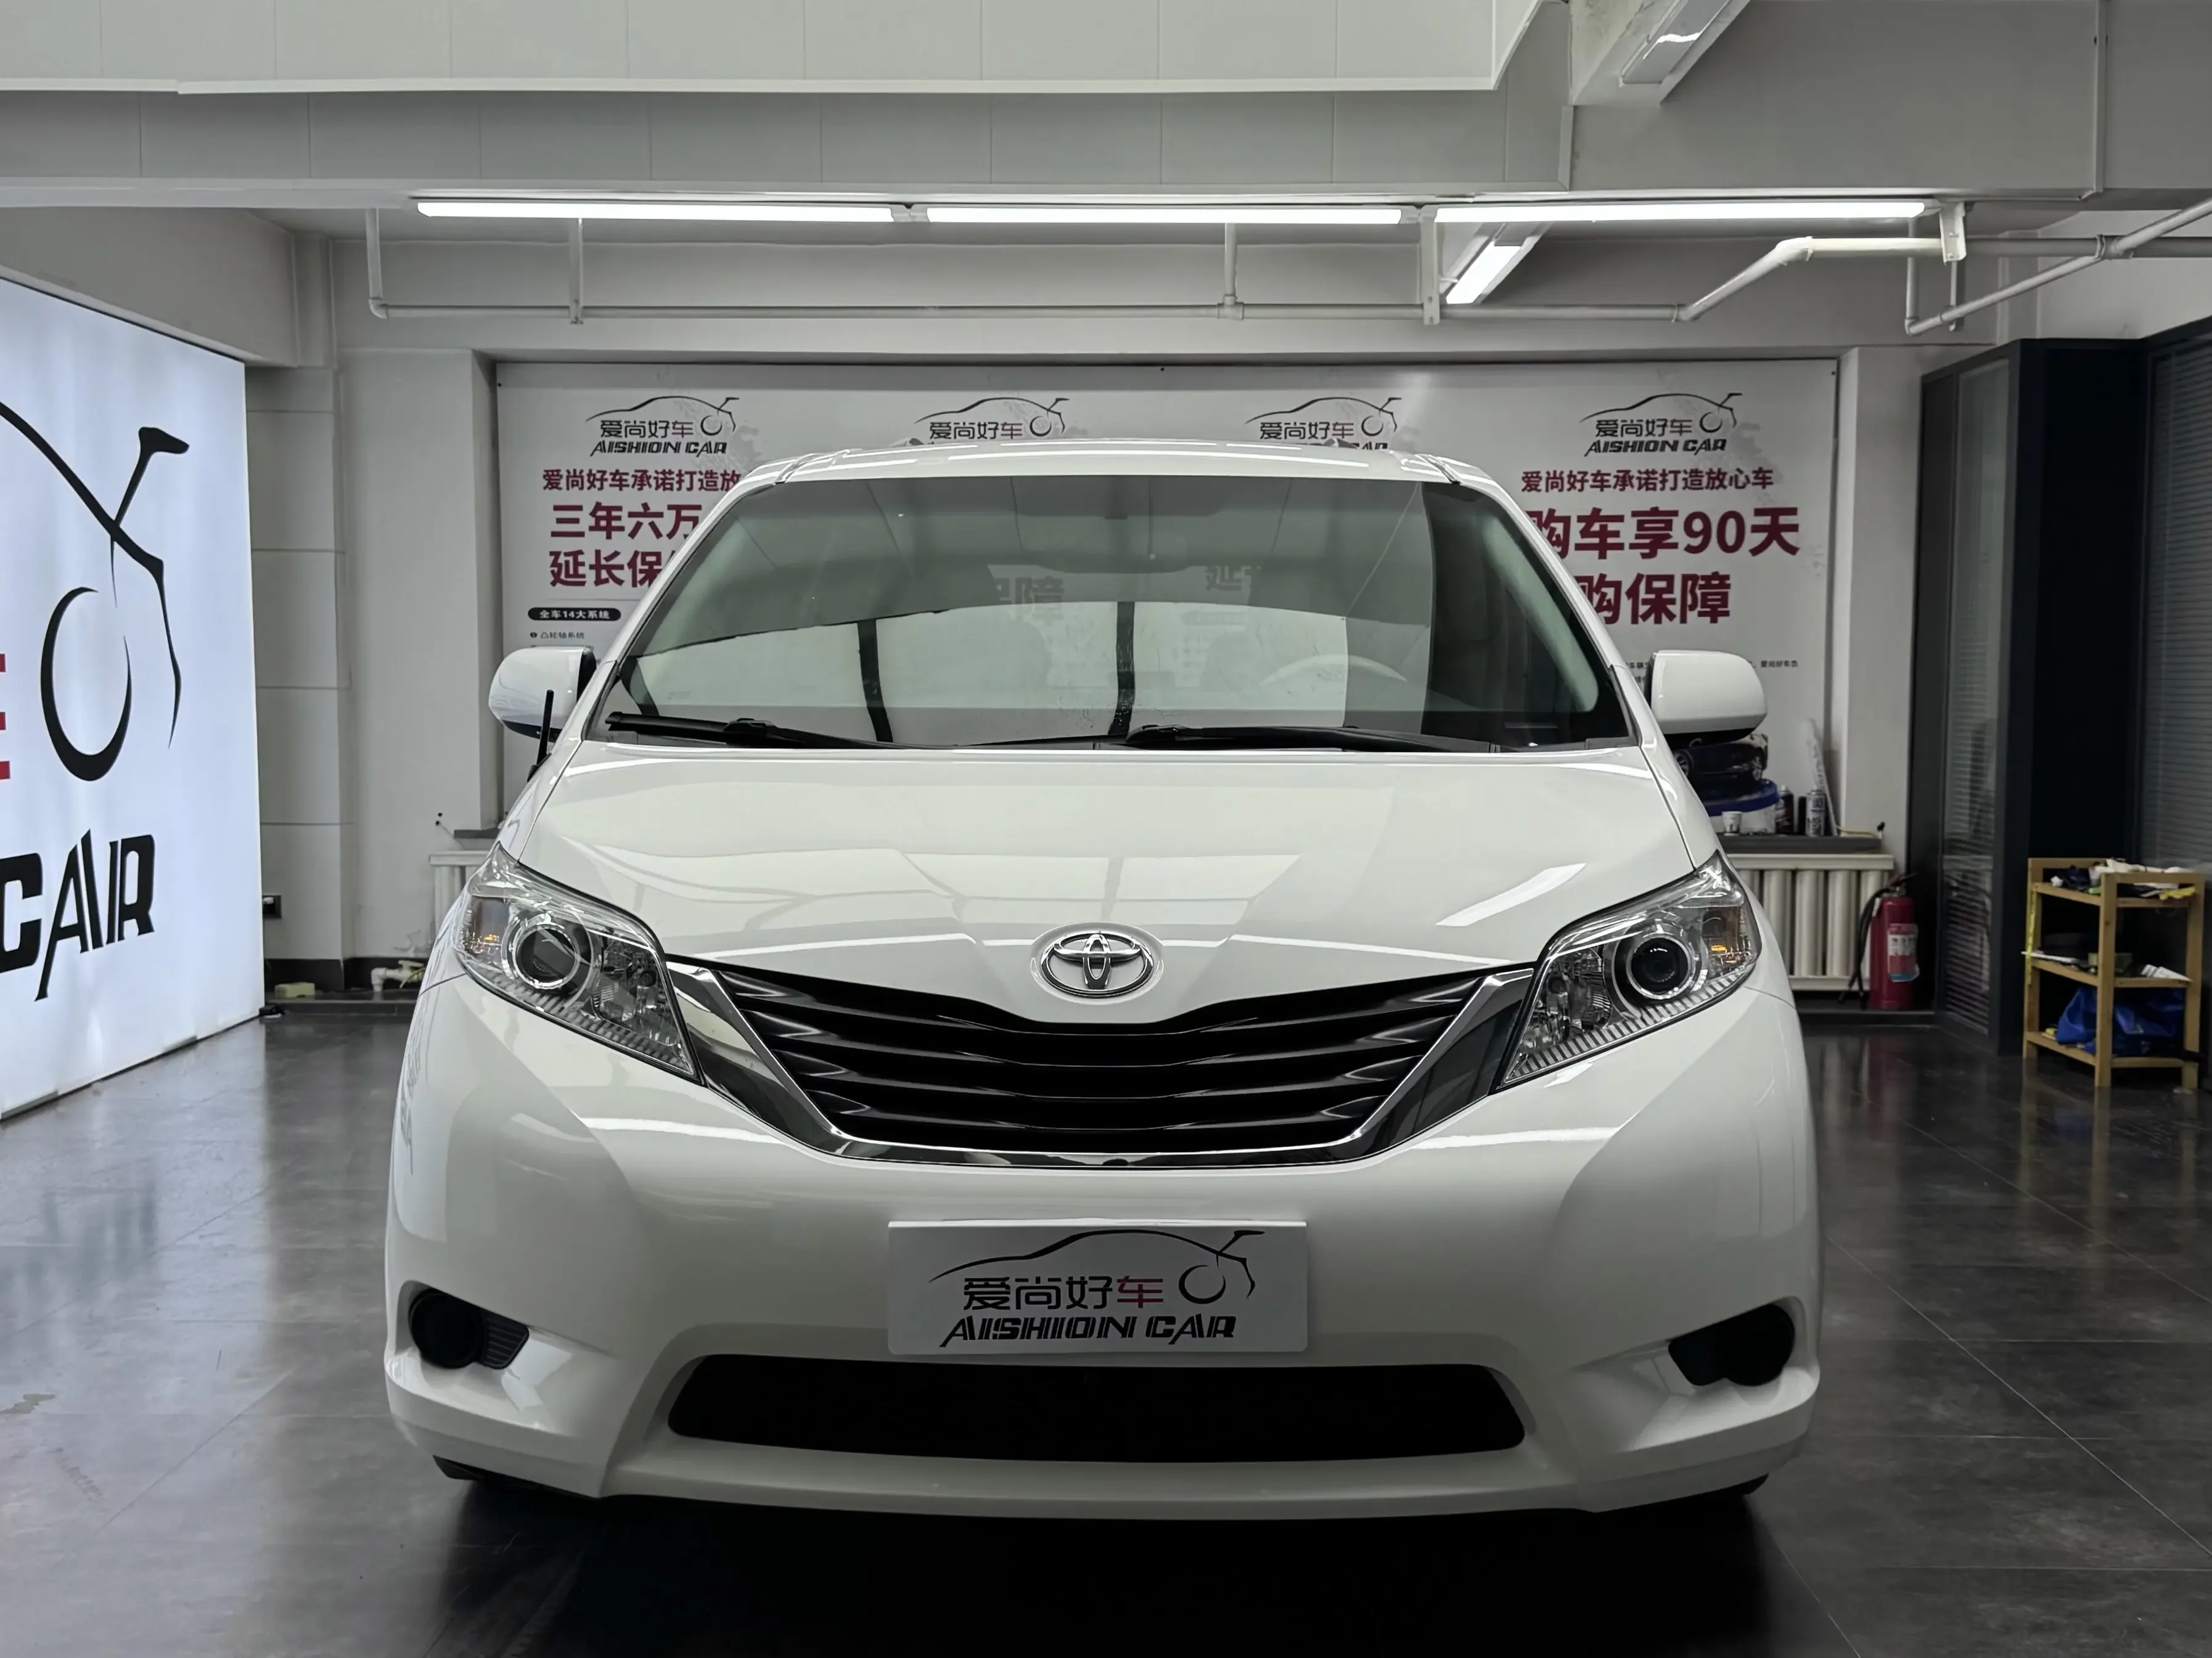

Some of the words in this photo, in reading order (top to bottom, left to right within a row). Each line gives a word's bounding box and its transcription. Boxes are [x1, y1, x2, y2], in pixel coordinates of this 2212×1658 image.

[600, 420, 694, 439] 爱尚好车
[930, 422, 1023, 439] 爱尚好车
[1260, 422, 1354, 439] 爱尚好车
[1596, 419, 1692, 438] 爱尚好车
[686, 440, 727, 457] CAR
[1682, 438, 1727, 455] CAR
[1522, 467, 1774, 492] 爱尚好车承诺打造放心车
[551, 501, 702, 540] 三年六万
[1525, 506, 1800, 560] 购车享90天
[549, 549, 675, 587] 延长保
[963, 1276, 1163, 1310] 爱尚好车
[940, 1315, 1137, 1347] AISHION
[1145, 1313, 1237, 1345] CAR
